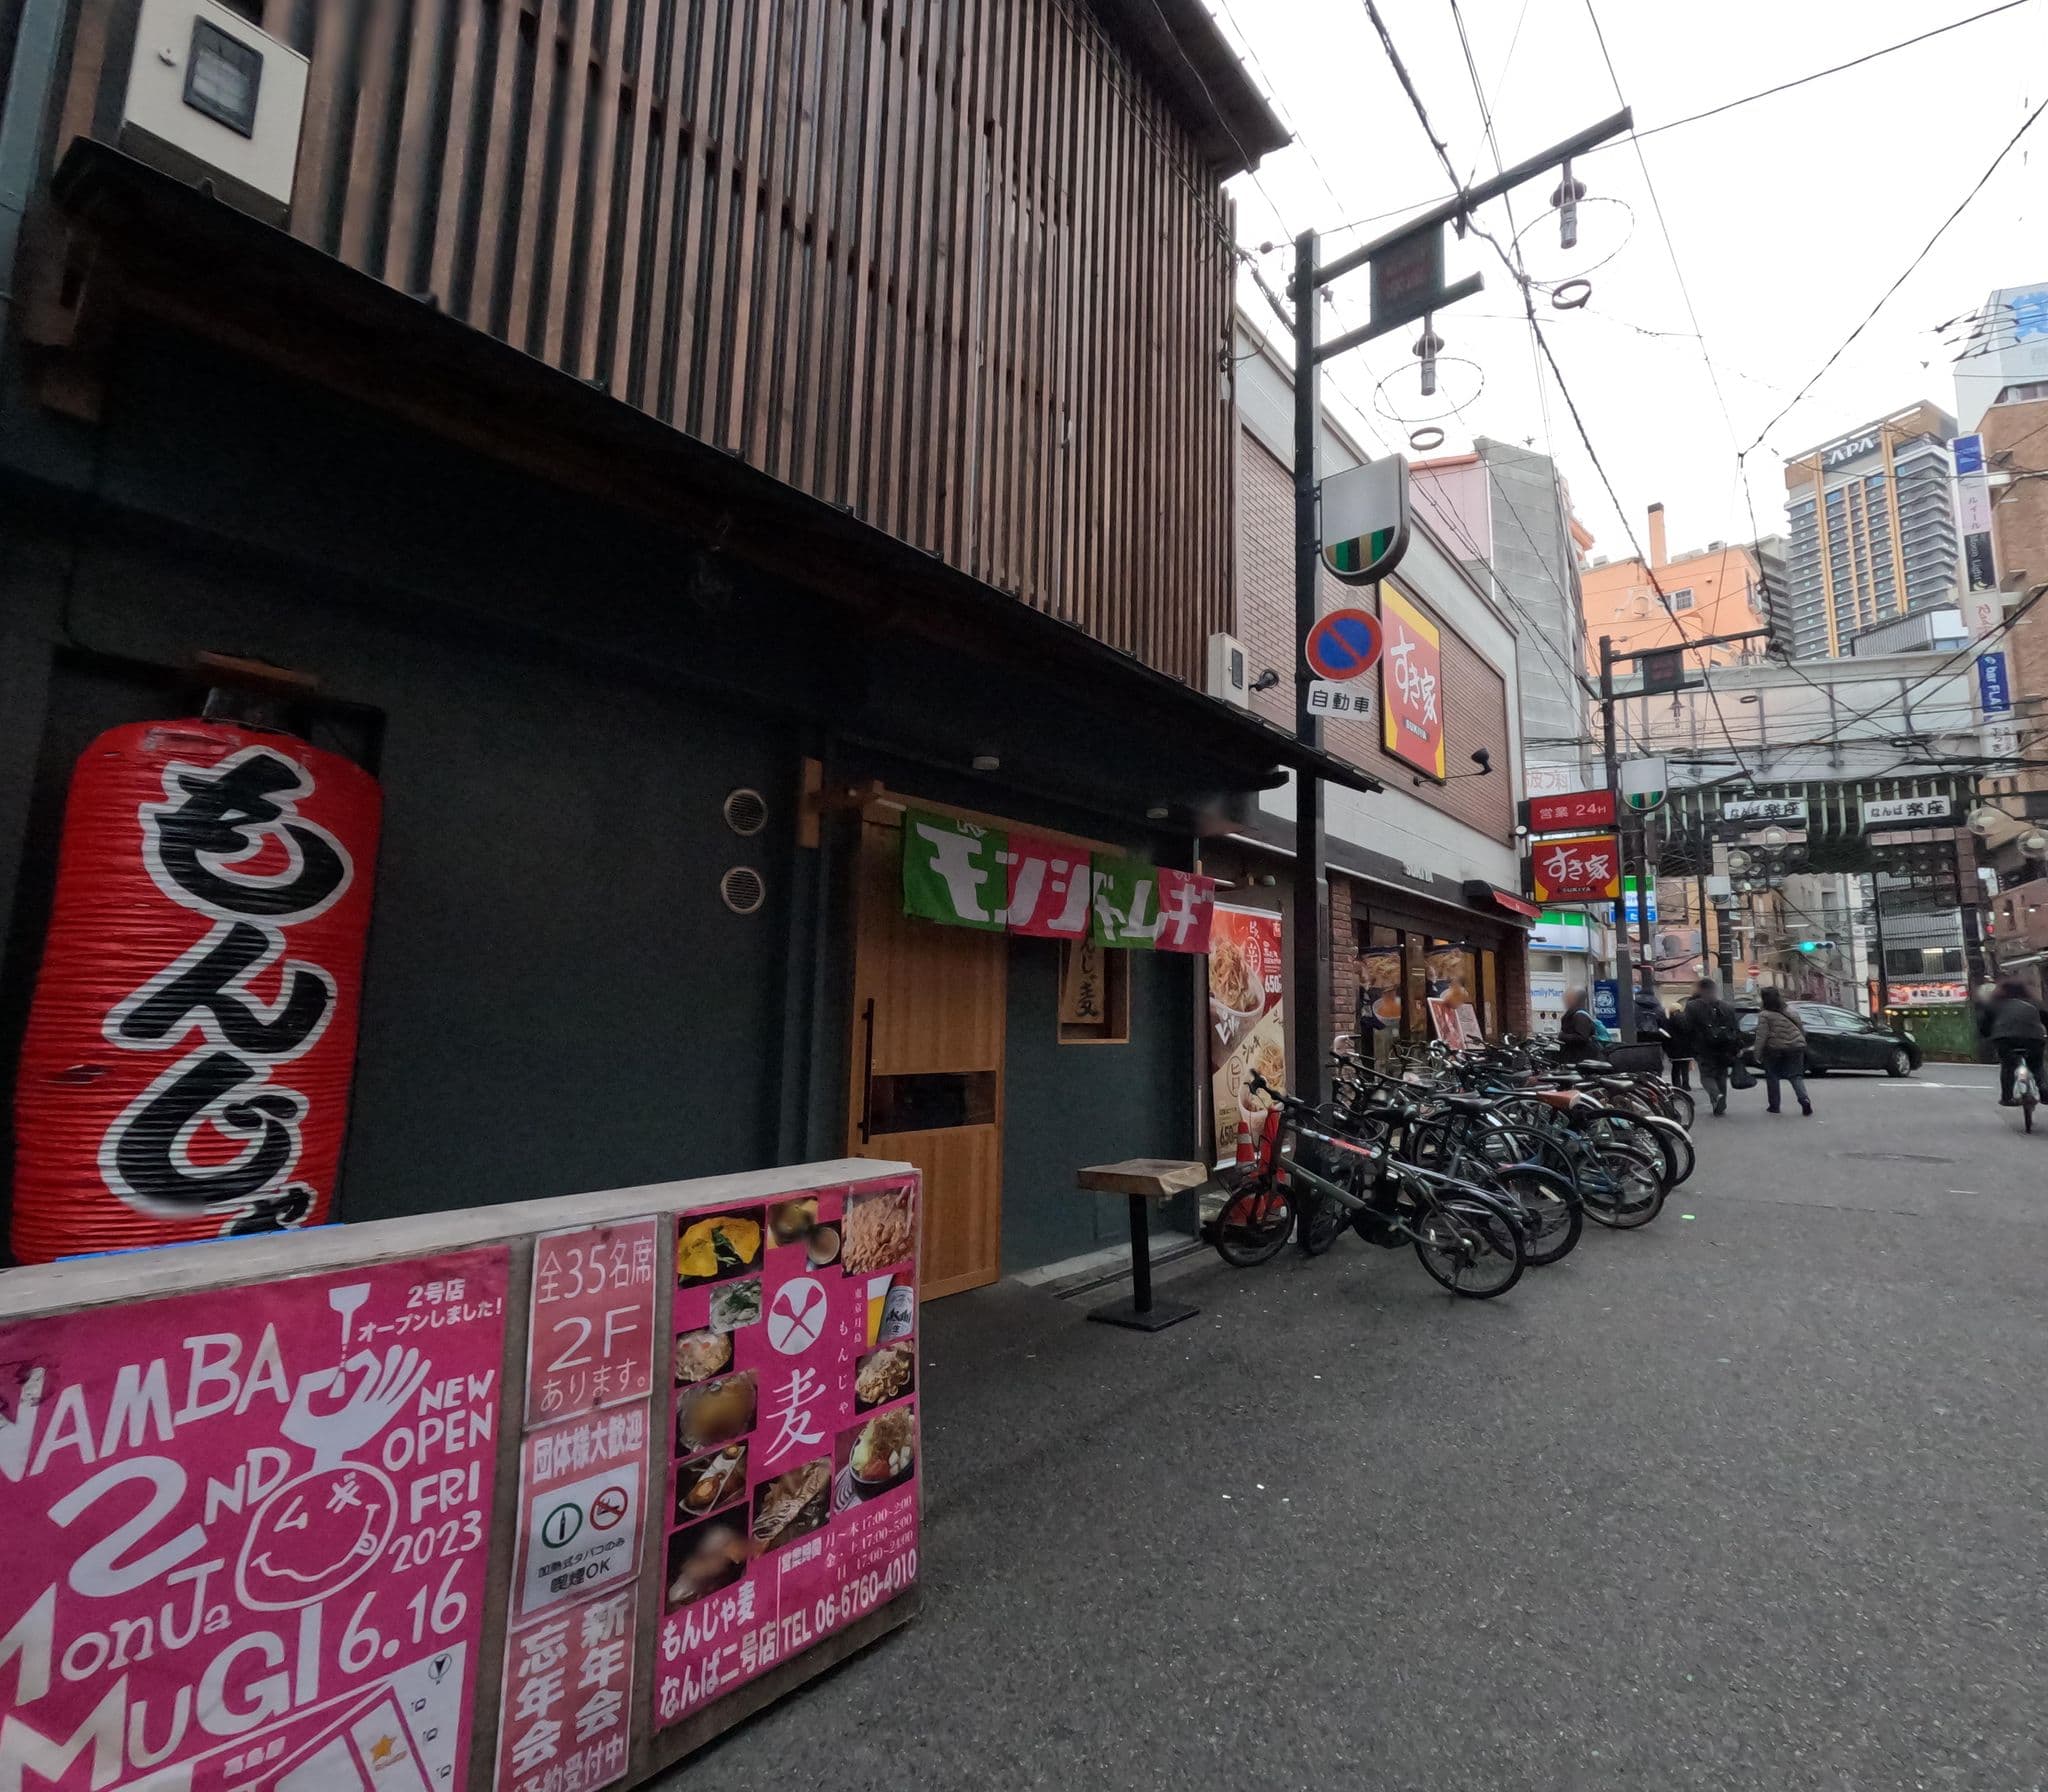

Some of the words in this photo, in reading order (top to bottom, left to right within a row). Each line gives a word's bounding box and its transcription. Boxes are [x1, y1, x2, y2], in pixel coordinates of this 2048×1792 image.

[1830, 437, 1874, 465] APA
[1311, 689, 1370, 713] 自動車
[1390, 625, 1438, 725] すき家
[1540, 807, 1568, 820] 営業
[1870, 800, 1945, 818] なんば楽座
[1543, 846, 1611, 886] すき家
[406, 1278, 465, 1309] 2号店
[538, 1237, 653, 1304] 全35名席
[357, 1297, 502, 1343] オープンしました!
[551, 1304, 640, 1373] 2F
[418, 1369, 495, 1417] NEW
[541, 1358, 647, 1413] あります。
[837, 1320, 849, 1415] もんじゃ
[382, 1402, 493, 1472] OPEN
[532, 1409, 643, 1485] 団体様大歓迎
[764, 1367, 826, 1467] 麦
[410, 1460, 480, 1524] FRI
[391, 1511, 482, 1575] 2023
[338, 1558, 467, 1675] 6.16
[661, 1579, 756, 1662] もんじゃ麦
[781, 1607, 813, 1653] TEL
[814, 1547, 918, 1635] 06-6760-4010
[511, 1619, 570, 1779] 忘年会
[575, 1592, 629, 1744] 新年会
[659, 1620, 778, 1719] なんば二号店
